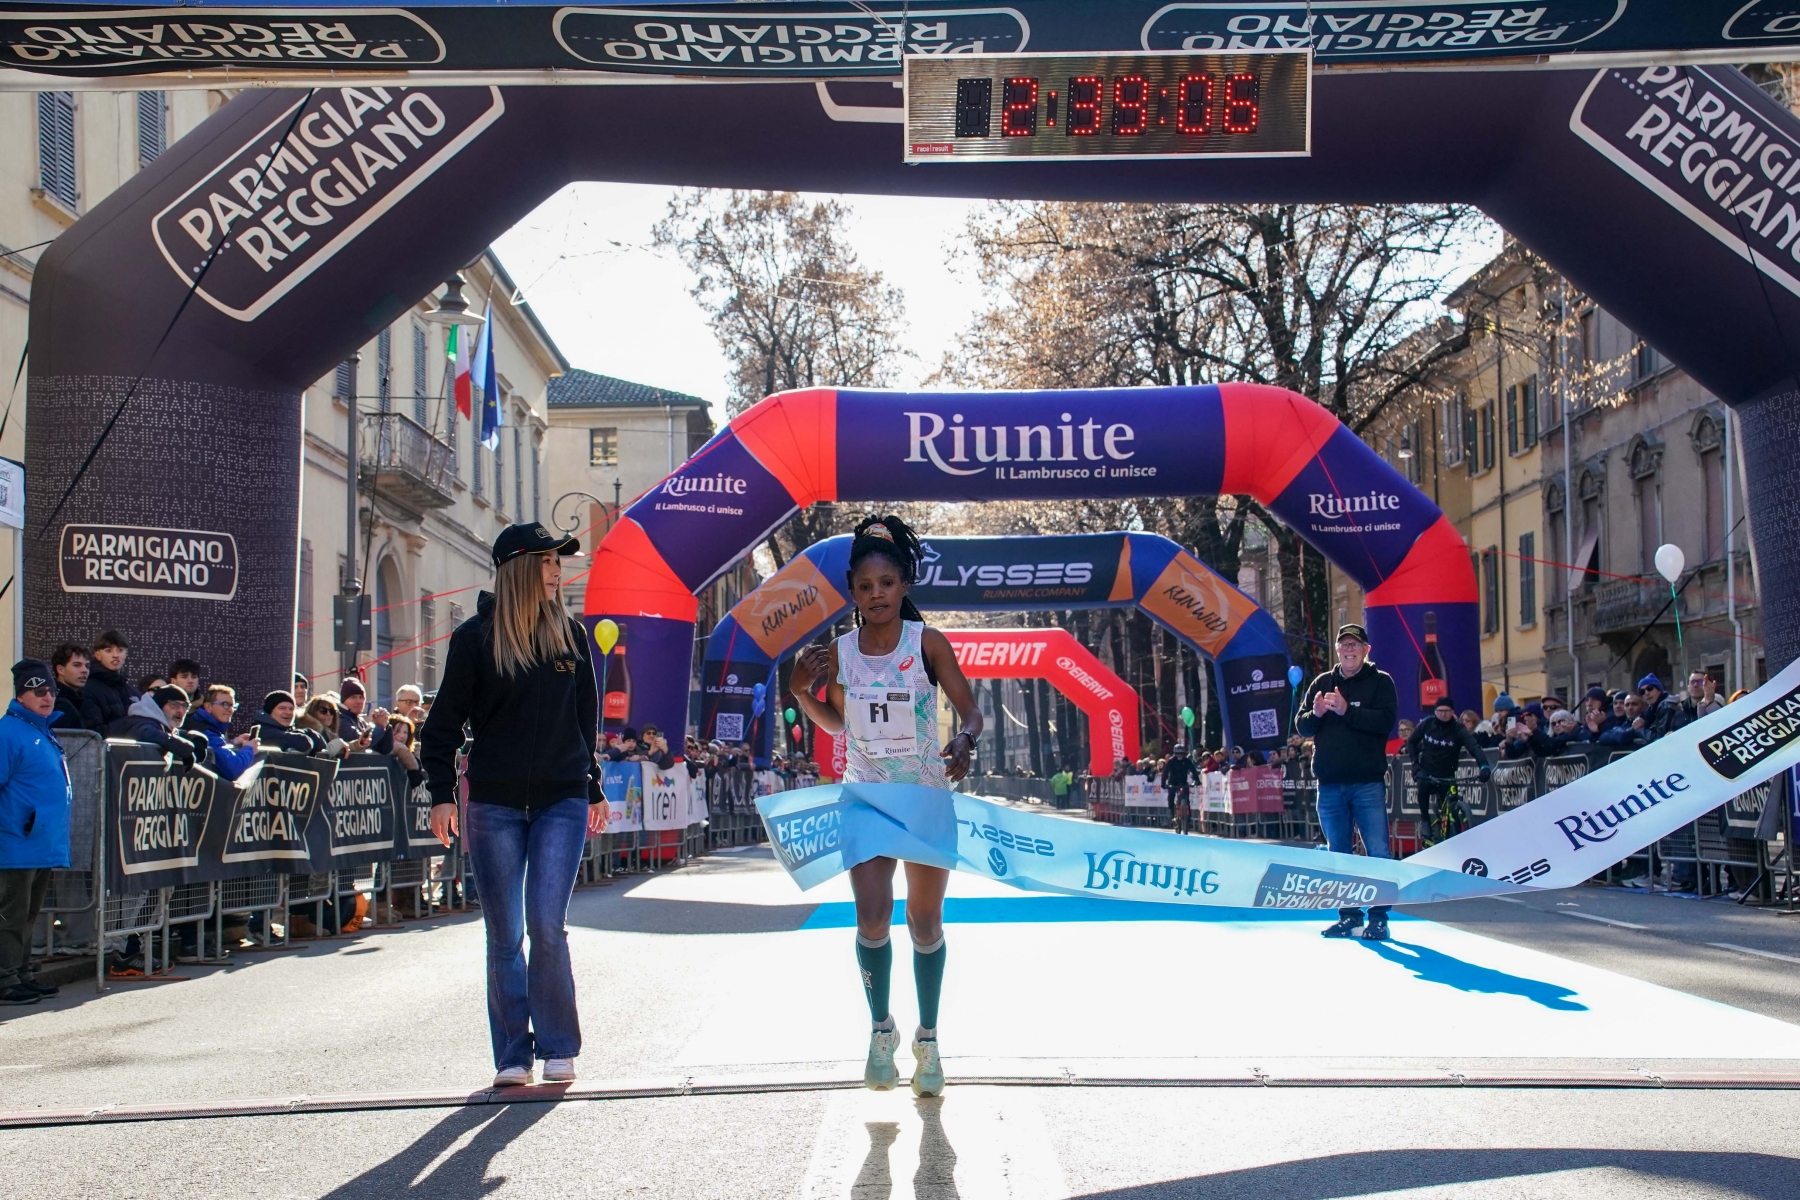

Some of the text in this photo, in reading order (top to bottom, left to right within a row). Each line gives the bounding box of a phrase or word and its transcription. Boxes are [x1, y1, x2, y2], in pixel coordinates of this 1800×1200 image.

[634, 22, 947, 43] REGGIANO
[1226, 7, 1547, 33] REGGIANO
[24, 23, 356, 44] REGGIANO
[1003, 76, 1257, 133] 2:39:06
[1636, 65, 1800, 196] PARMIGI
[236, 92, 446, 272] REGGIANO
[903, 412, 1135, 476] Riunite
[660, 473, 747, 496] Riunite
[995, 465, 1157, 480] Il Lambrusco ci unisce
[662, 503, 706, 512] Lambrusco
[707, 505, 715, 513] ci
[717, 506, 743, 515] unisce
[1308, 490, 1400, 519] Riunite
[1318, 525, 1363, 533] Lambrusco
[1364, 523, 1372, 532] ci
[1374, 522, 1401, 531] unisce
[72, 533, 223, 563] PARMIGIANO
[85, 558, 209, 586] REGGIANO
[983, 587, 1087, 598] RUNNING COMPANY
[706, 685, 754, 695] ULYSSE
[1068, 667, 1114, 700] ENERVIT
[1231, 679, 1286, 695] ULYSSES
[869, 702, 889, 723] F1
[885, 747, 911, 755] Riunite
[1732, 711, 1800, 765] REGGIA
[652, 792, 676, 820] iren
[1554, 772, 1690, 852] Riunite
